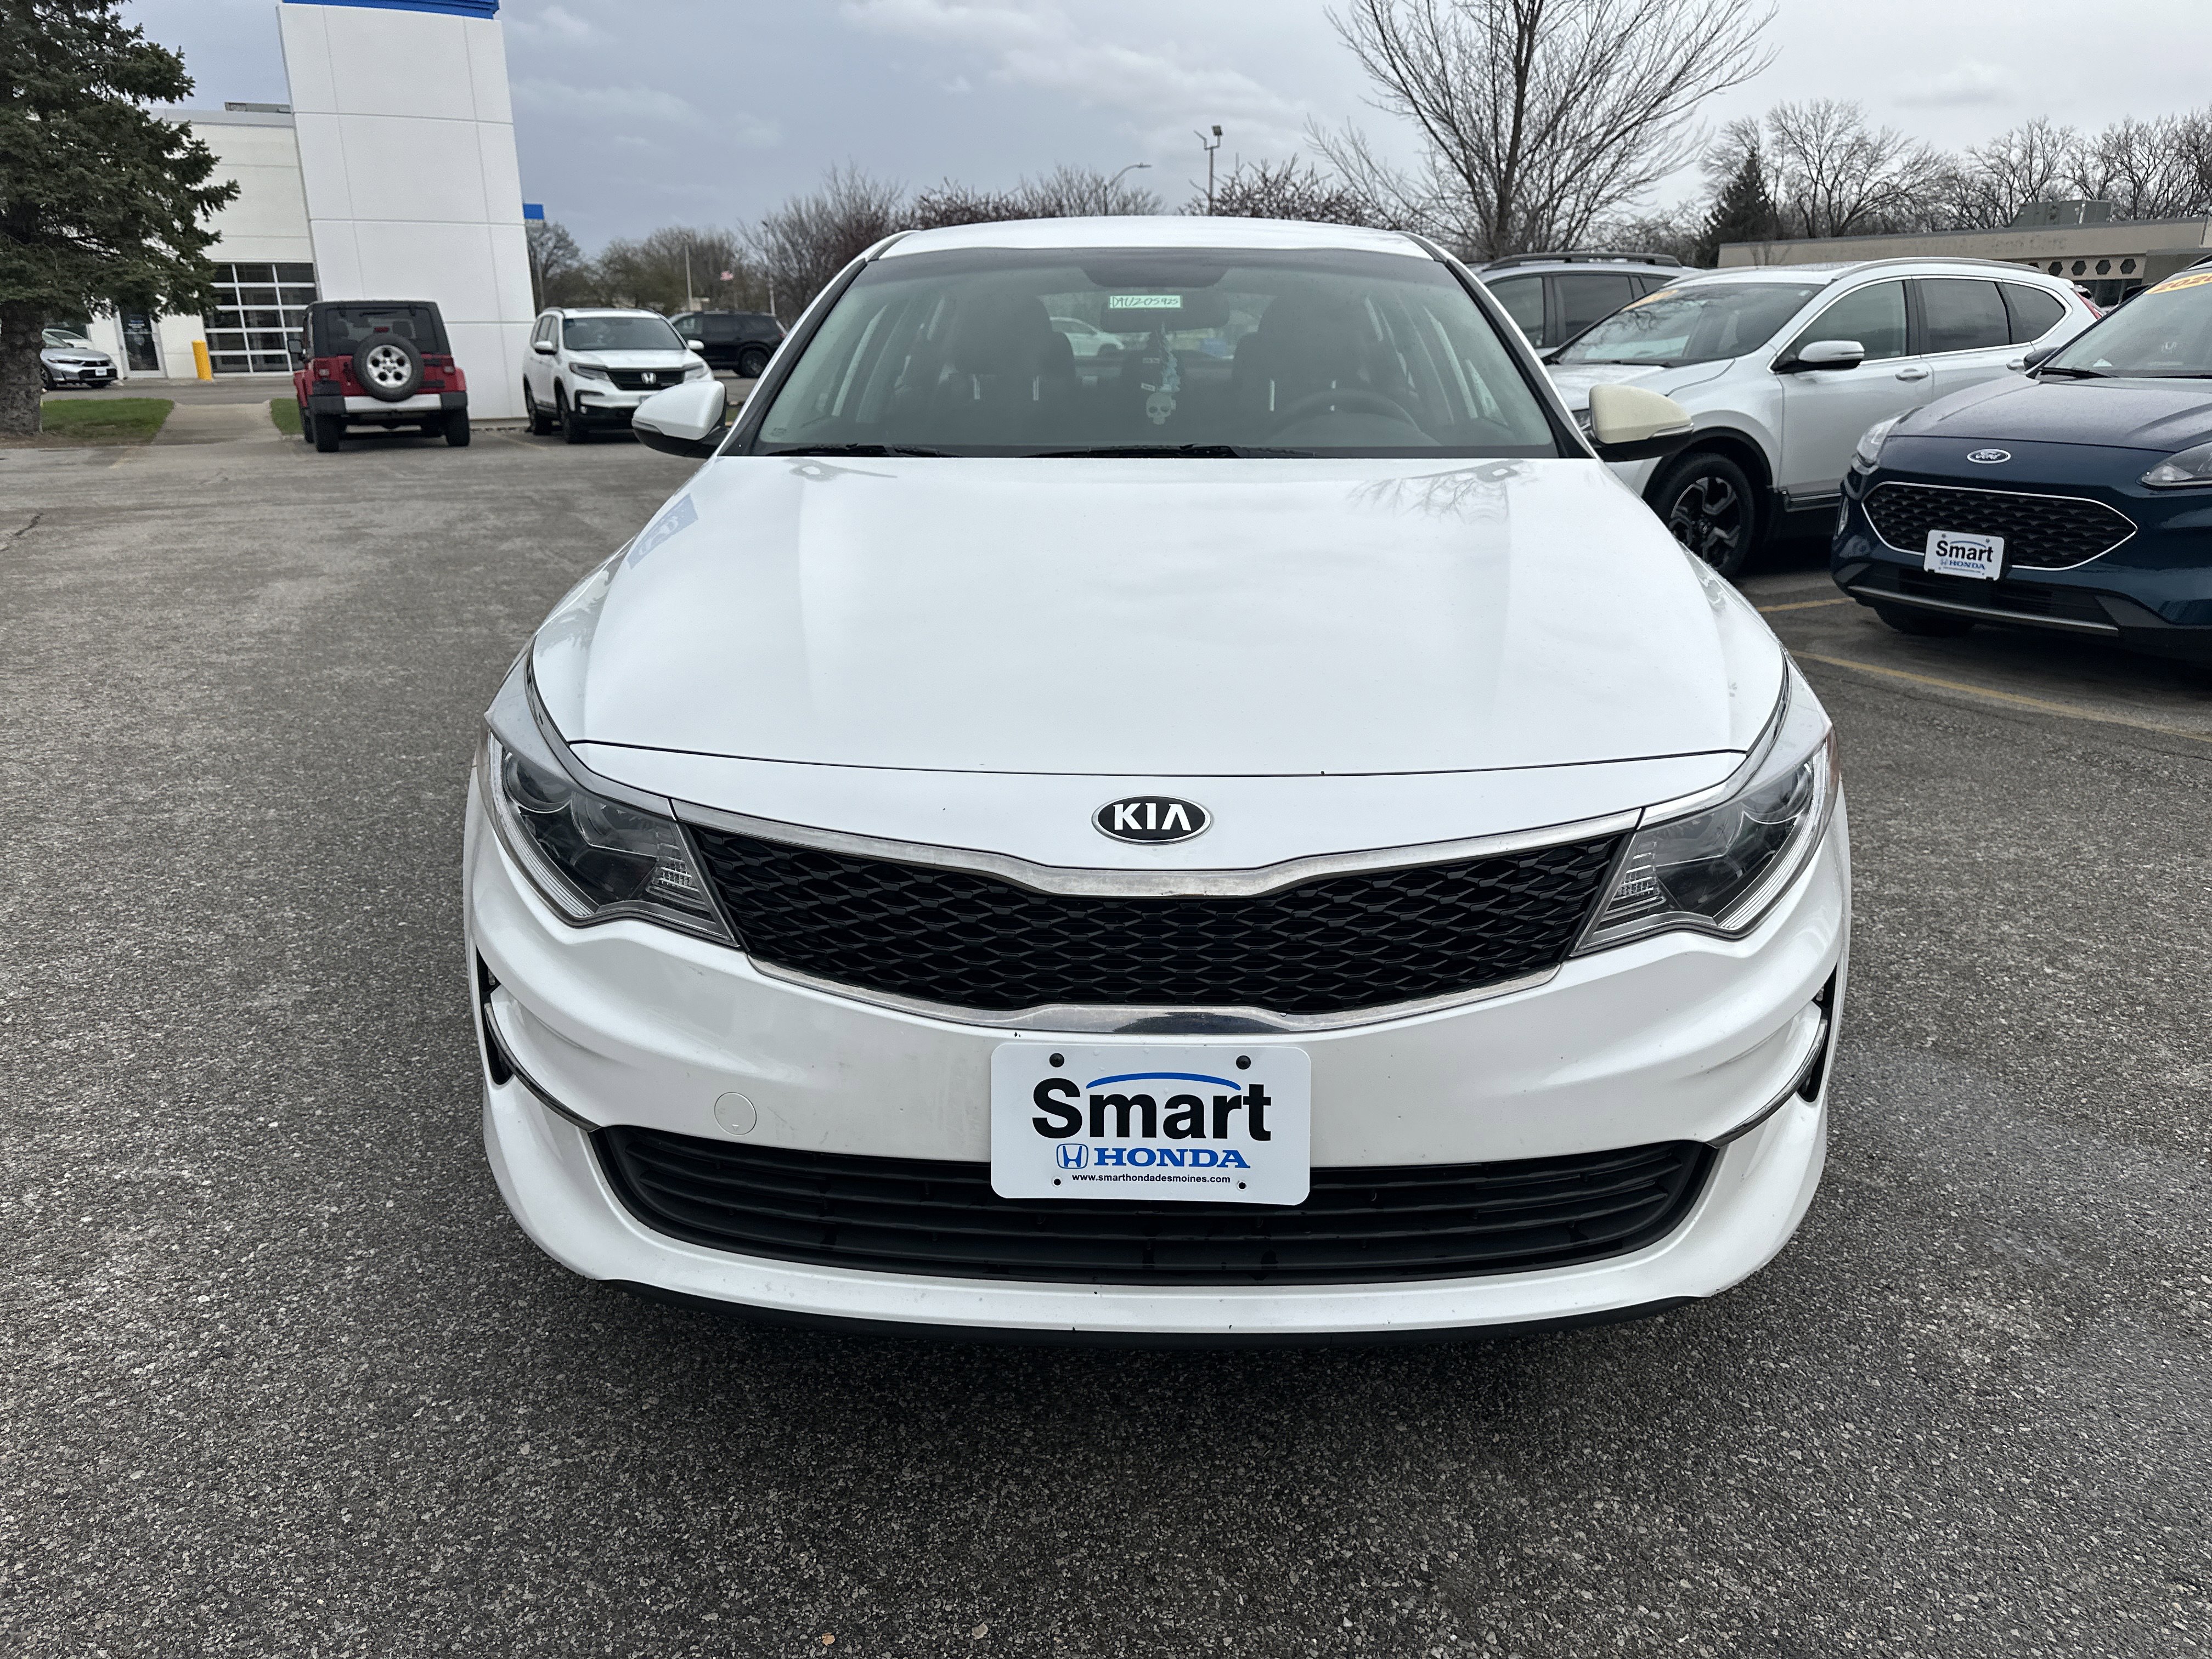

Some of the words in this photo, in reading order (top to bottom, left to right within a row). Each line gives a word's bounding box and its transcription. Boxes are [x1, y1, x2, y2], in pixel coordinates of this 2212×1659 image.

[1976, 450, 2001, 460] Ford
[1936, 540, 1994, 562] Smart
[1949, 560, 1985, 570] HONDA
[1113, 803, 1192, 831] KIA
[1032, 1077, 1272, 1141] Smart
[1094, 1147, 1251, 1169] HONDA
[1071, 1173, 1231, 1184] www.smarthondadesmoines.com
